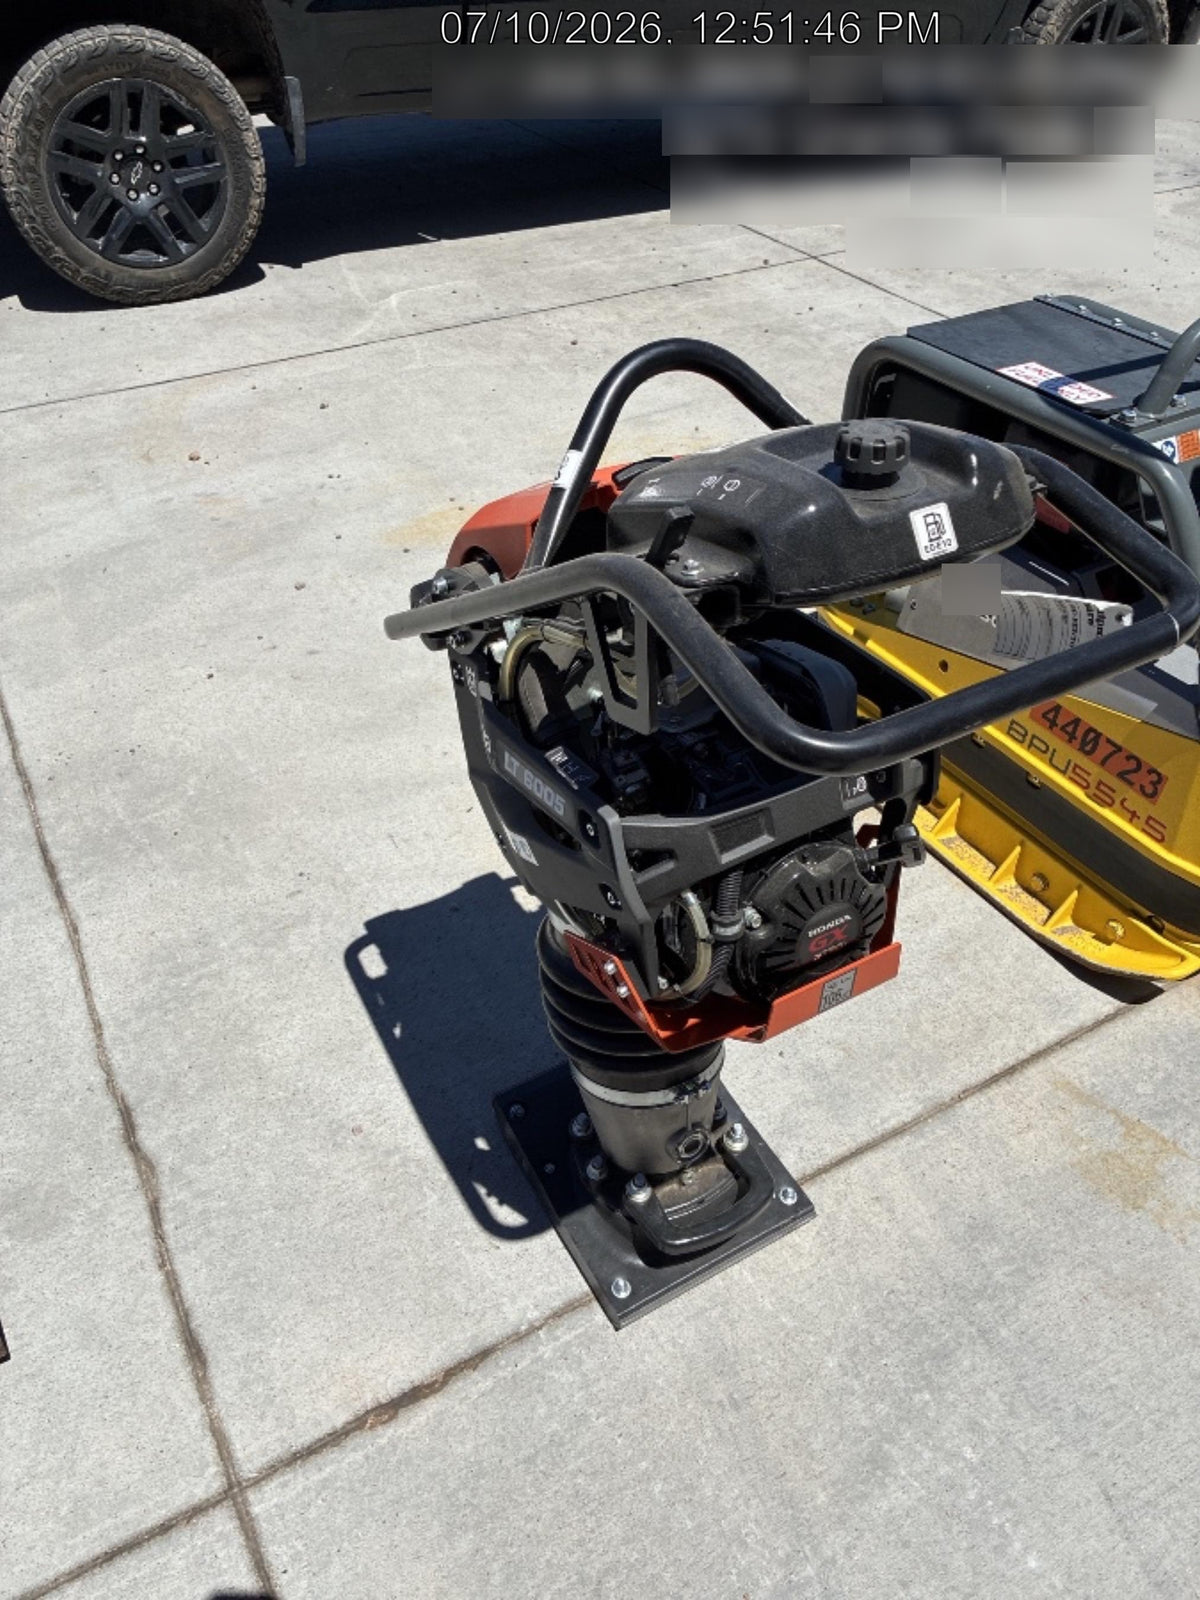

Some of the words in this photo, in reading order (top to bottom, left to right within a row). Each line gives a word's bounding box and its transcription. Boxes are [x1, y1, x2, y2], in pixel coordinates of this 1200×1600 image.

[1006, 718, 1167, 843] BPU5545
[1041, 703, 1164, 799] 440723
[808, 914, 853, 938] HONDA
[808, 924, 850, 953] GX
